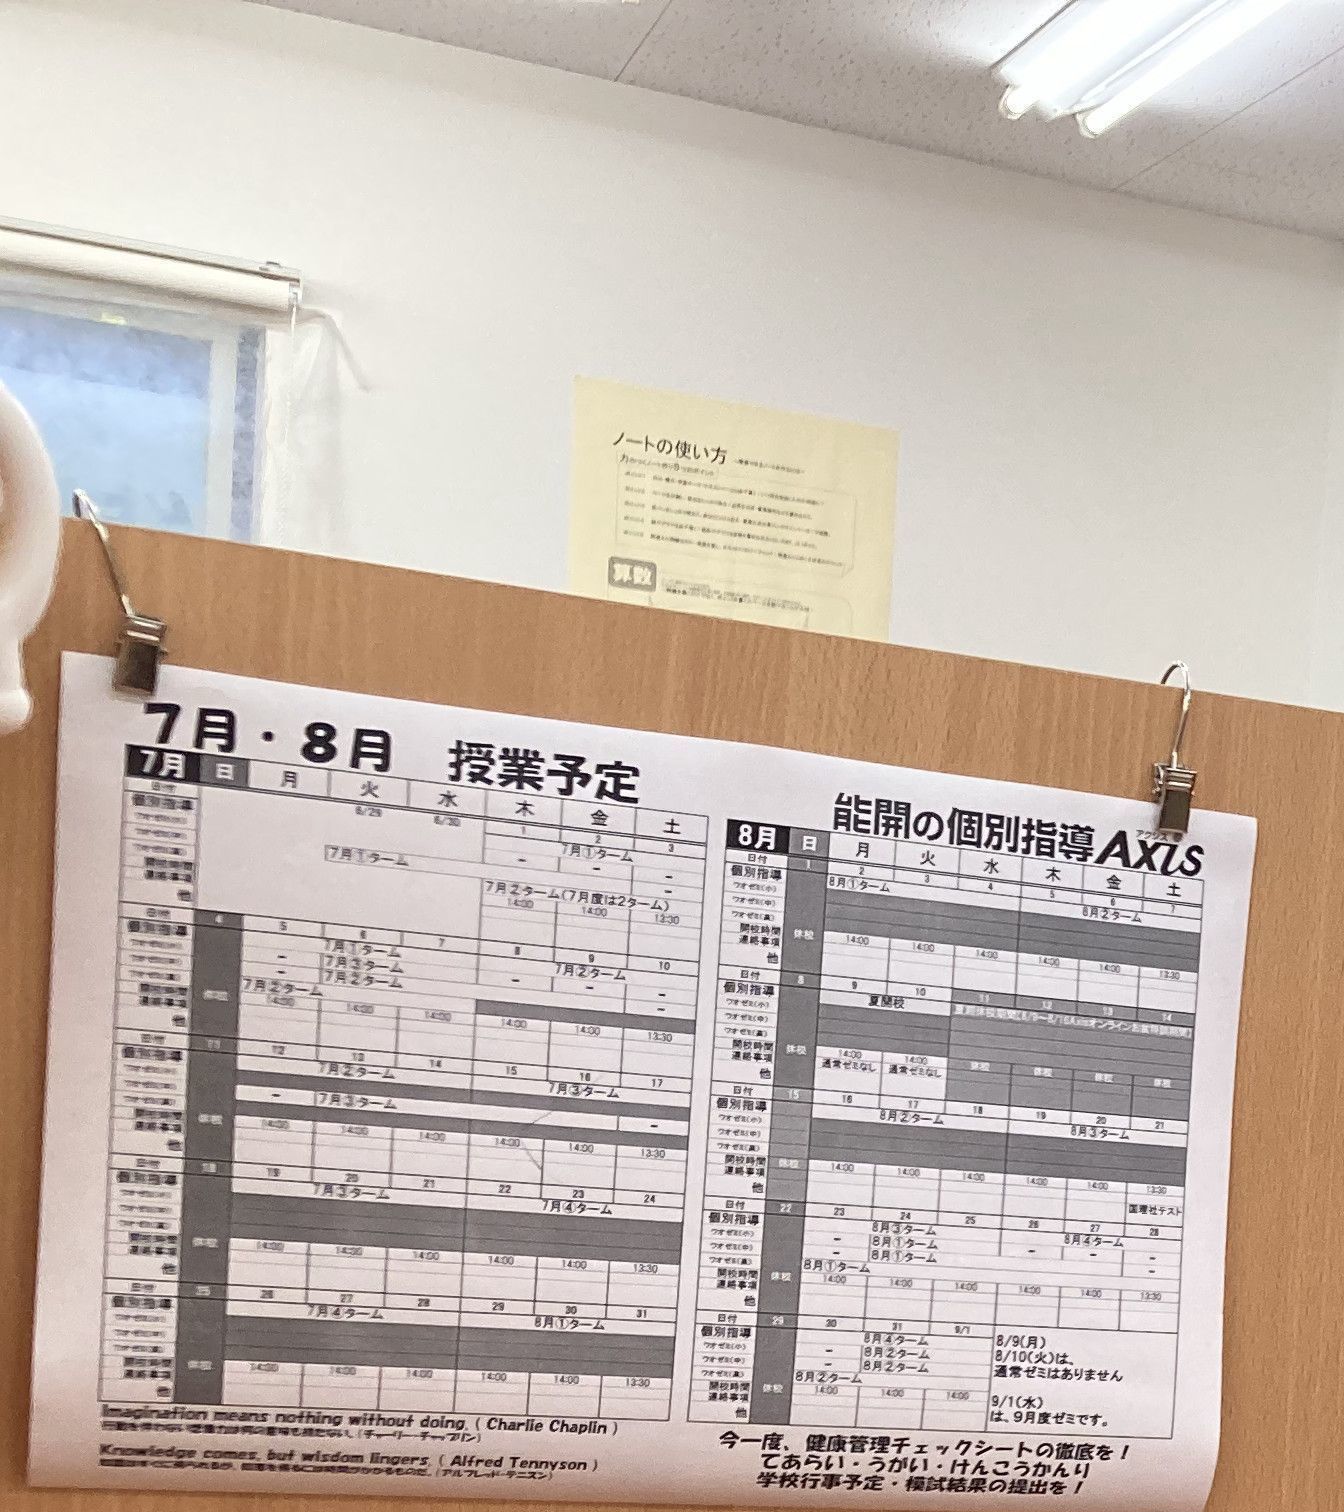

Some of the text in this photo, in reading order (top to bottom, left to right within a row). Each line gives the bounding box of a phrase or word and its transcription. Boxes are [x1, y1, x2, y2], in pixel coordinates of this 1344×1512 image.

[613, 432, 728, 465] ノートの使い方
[143, 702, 640, 804] 7月・8月 授業予定
[139, 750, 680, 834] 7月 日 月 火 水 木 金 土
[738, 824, 1181, 897] 8月 日 月 火 水 木 金 土
[748, 853, 768, 864] 日付
[658, 961, 670, 970] 10
[740, 969, 760, 980] 日付
[852, 981, 858, 990] 9
[916, 988, 926, 996] 10
[505, 1066, 518, 1076] 15
[651, 1078, 663, 1088] 17
[733, 1086, 753, 1096] 日付
[842, 1095, 853, 1104] 16
[908, 1100, 919, 1109] 17
[1155, 1121, 1165, 1129] 21
[569, 1143, 594, 1153] 14:00
[424, 1178, 656, 1204] 21 22 23 24
[725, 1199, 745, 1209] 日付
[780, 1204, 792, 1213] 22
[834, 1207, 845, 1216] 23
[900, 1212, 911, 1220] 24
[1090, 1224, 1100, 1233] 27
[488, 1256, 514, 1265] 14:00
[562, 1260, 588, 1270] 14:00
[566, 1306, 578, 1314] 30
[636, 1310, 648, 1318] 31
[717, 1313, 738, 1324] 日付
[996, 1334, 1047, 1350] 8/9(月)
[480, 1372, 650, 1388] 14:00 14:00 13:30
[993, 1365, 1123, 1382] 通常ゼミはありません
[991, 1395, 1043, 1410] 9/1(水)
[102, 1404, 209, 1420] Imagination
[214, 1410, 269, 1423] means
[276, 1412, 342, 1427] nothing
[349, 1411, 413, 1430] without
[100, 1444, 198, 1458] Knowledge
[268, 1450, 294, 1462] but
[302, 1450, 364, 1464] wisdom
